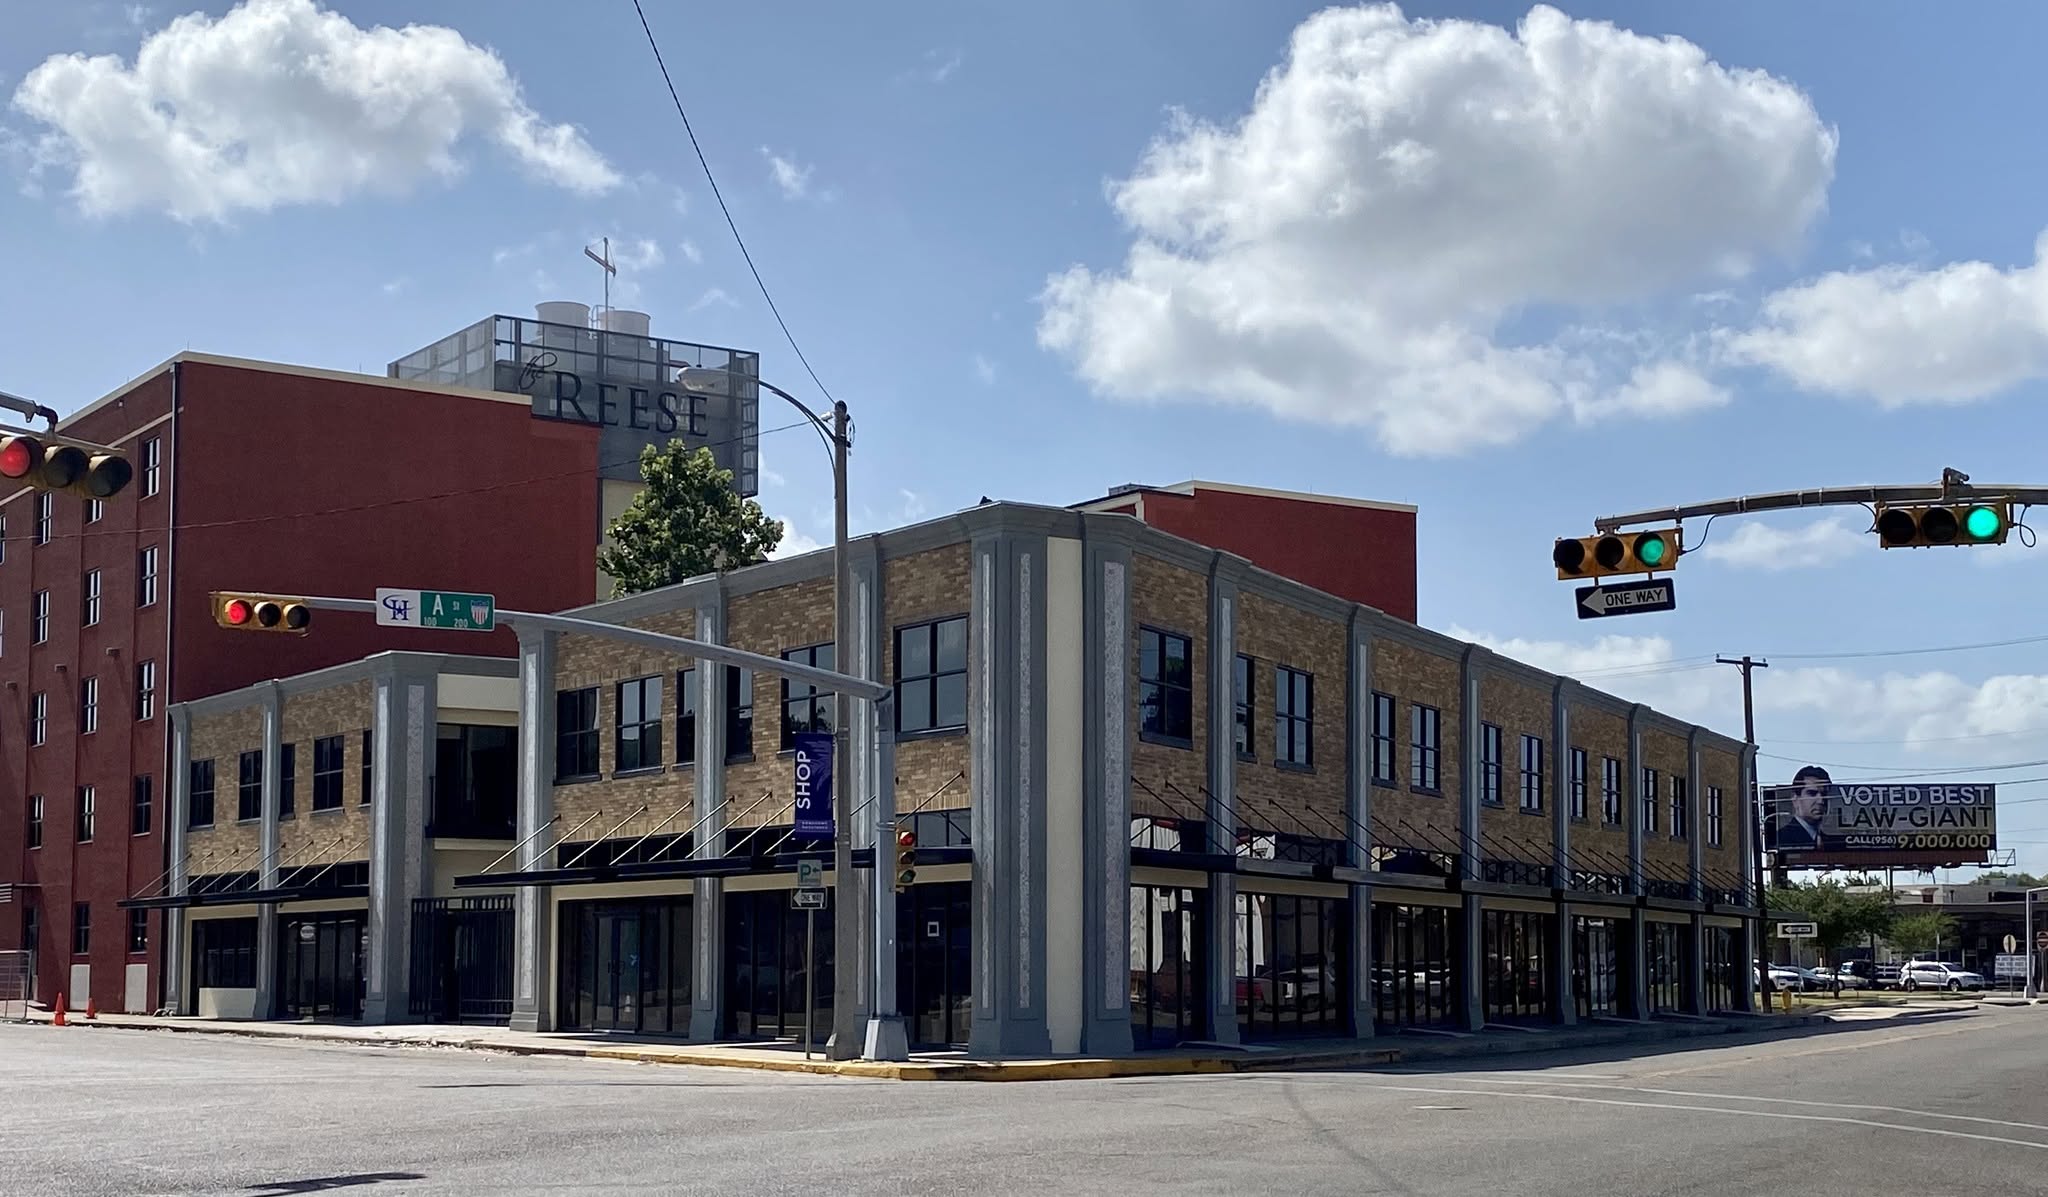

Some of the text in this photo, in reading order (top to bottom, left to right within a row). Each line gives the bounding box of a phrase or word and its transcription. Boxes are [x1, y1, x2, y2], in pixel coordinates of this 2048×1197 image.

[432, 594, 444, 616] A
[1605, 589, 1662, 606] ONE WAY
[424, 616, 468, 628] 100 200
[797, 750, 811, 809] SHOP
[1839, 786, 1990, 805] VOTED BEST
[1898, 834, 1990, 848] 9,000,000
[800, 864, 811, 882] P
[800, 894, 811, 902] ONE
